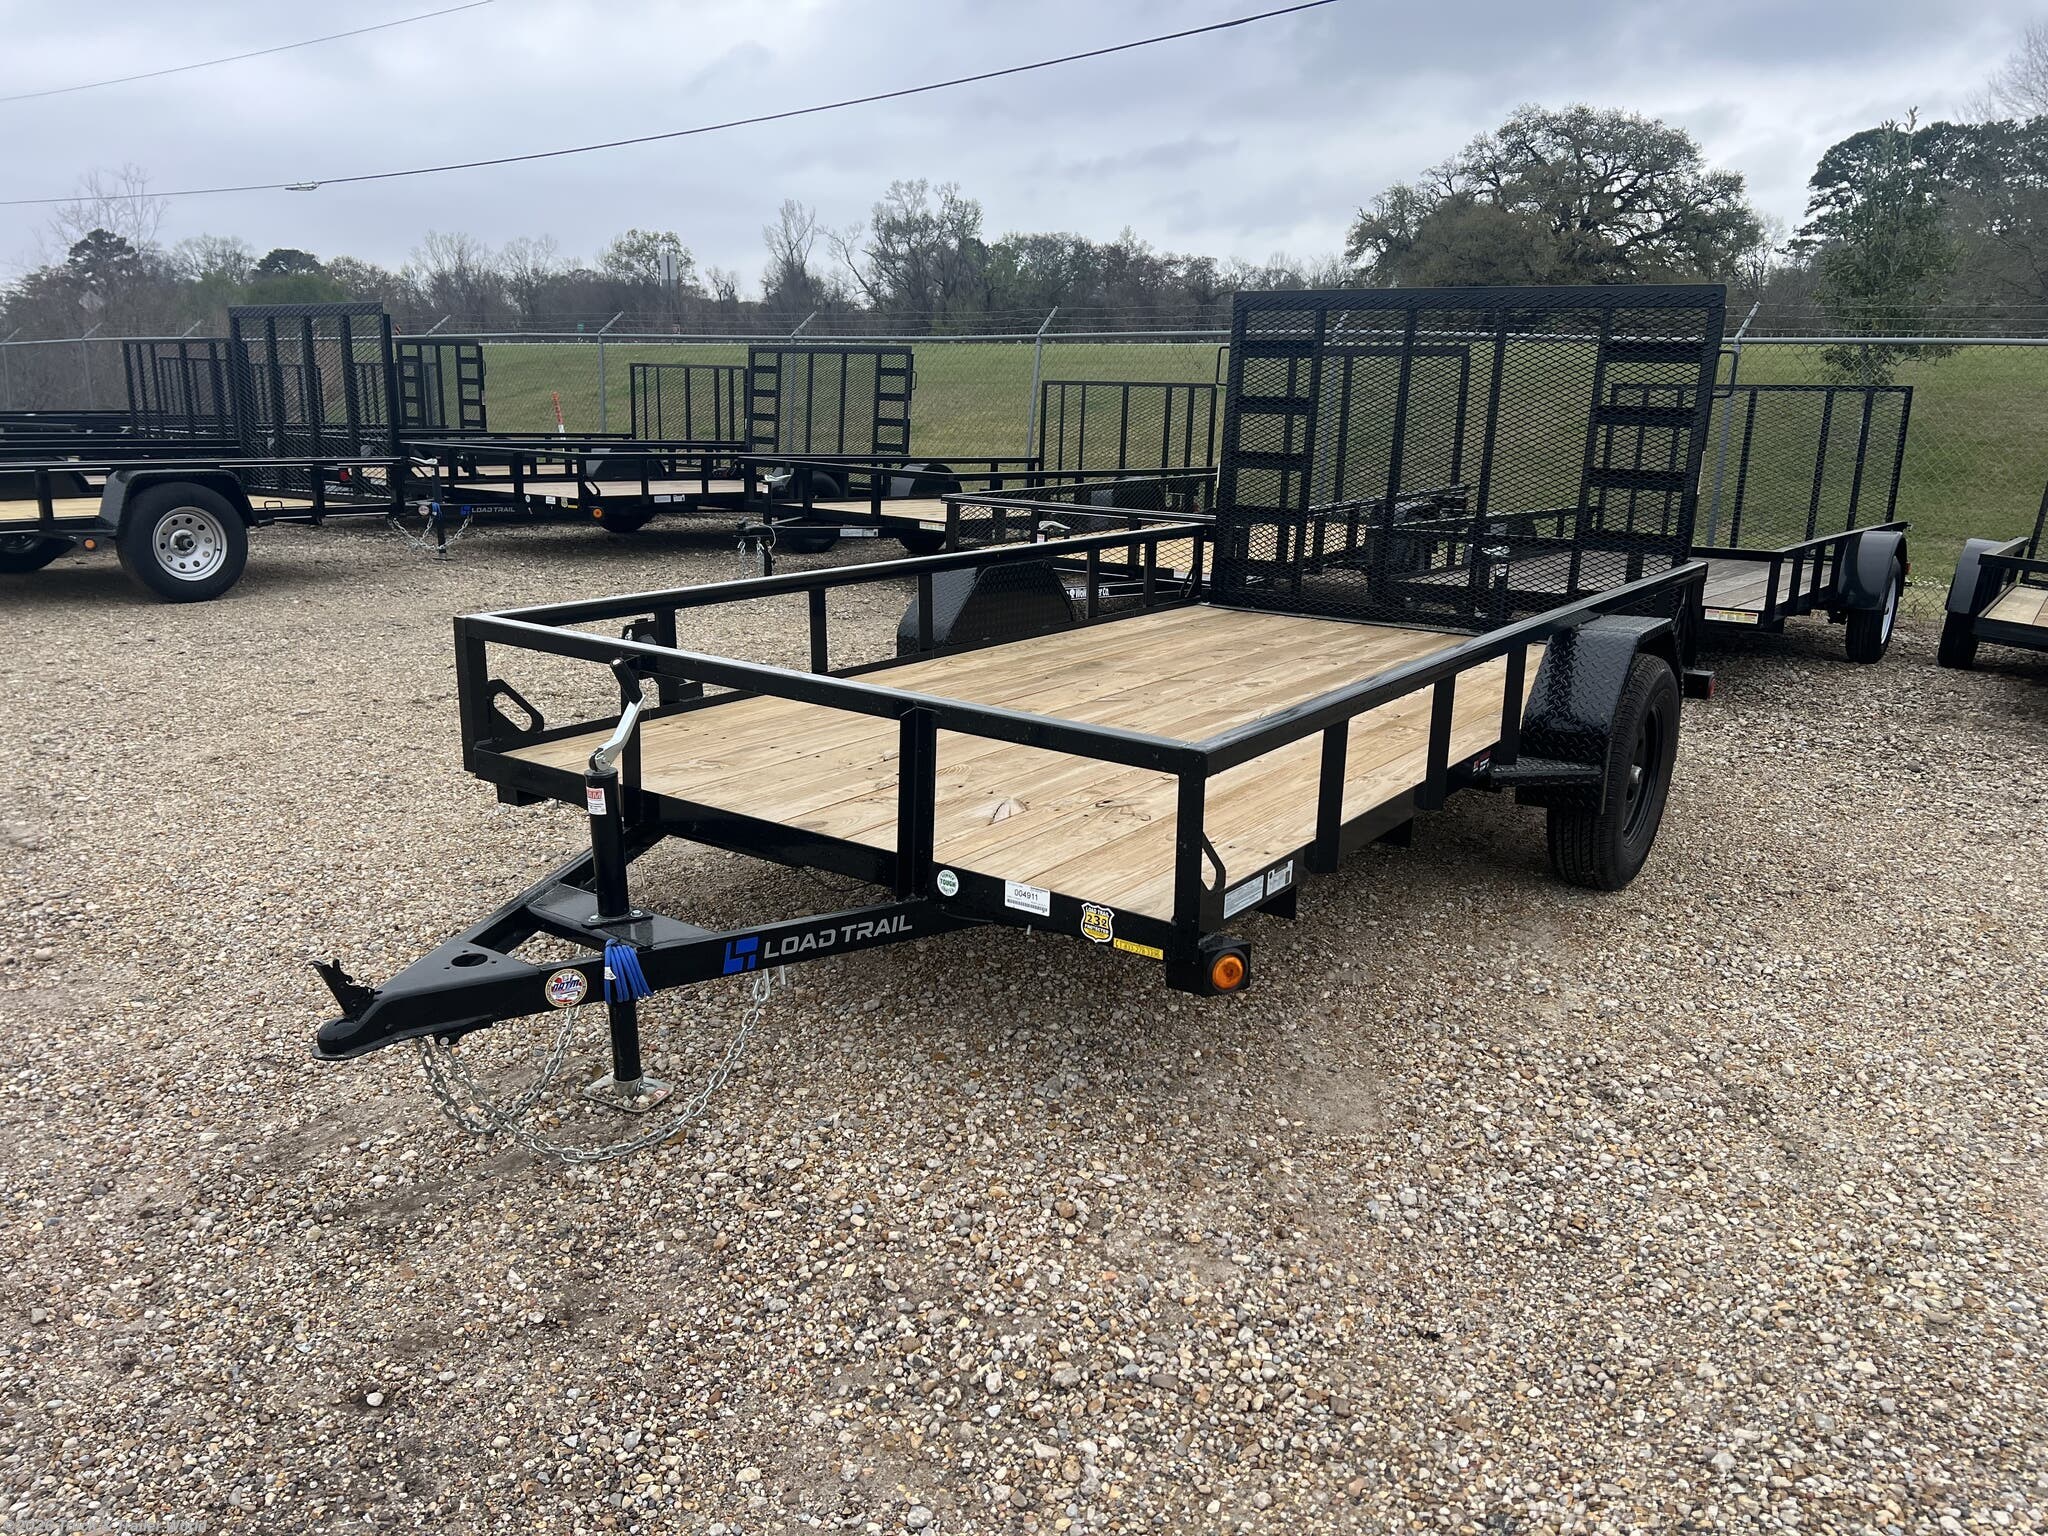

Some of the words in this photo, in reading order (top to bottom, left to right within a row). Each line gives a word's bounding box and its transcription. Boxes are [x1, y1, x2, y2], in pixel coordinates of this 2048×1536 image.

[1014, 888, 1038, 901] 004911
[1087, 914, 1107, 927] 232
[764, 928, 836, 959] LOAD
[841, 914, 913, 943] TRAIL
